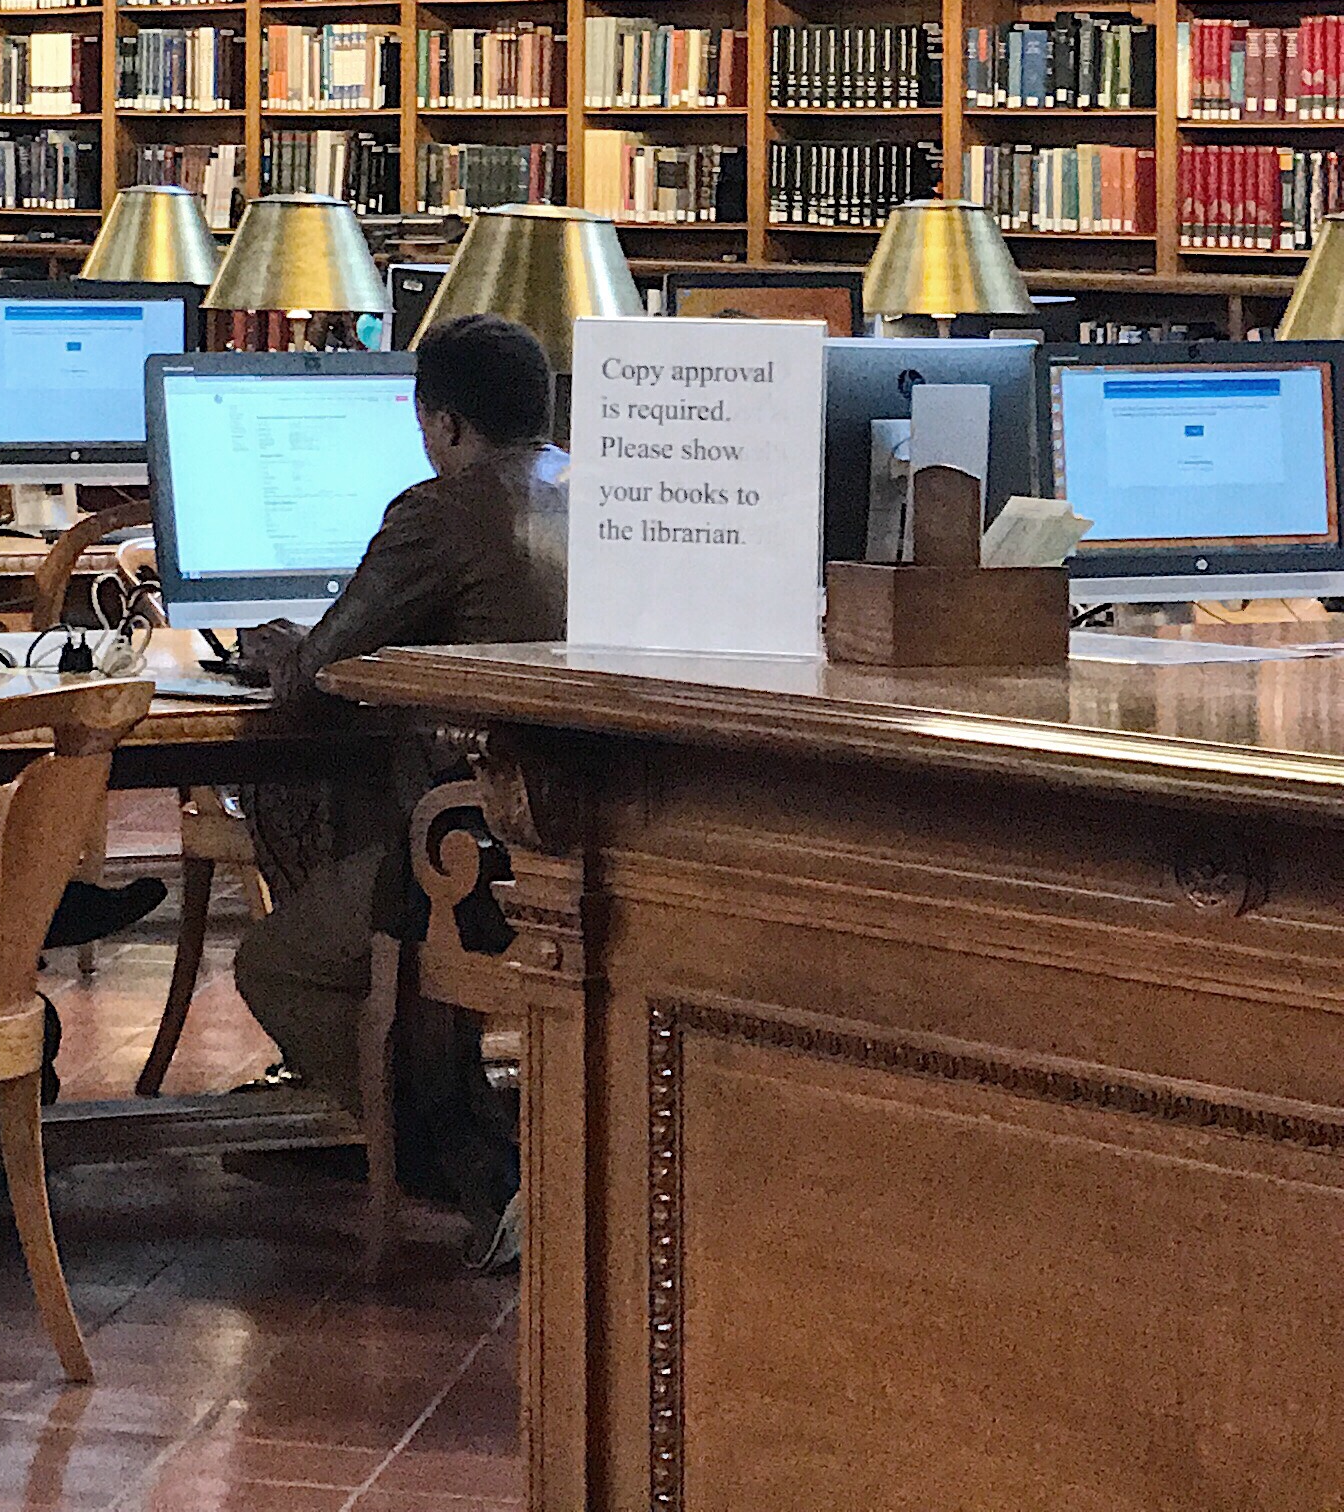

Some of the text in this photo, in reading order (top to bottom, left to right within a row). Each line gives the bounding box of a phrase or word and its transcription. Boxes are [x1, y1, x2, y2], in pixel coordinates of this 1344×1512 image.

[601, 357, 774, 388] Copy approval
[600, 396, 732, 426] is required.
[600, 436, 744, 461] Please show
[599, 481, 760, 507] your books to
[599, 519, 747, 545] the librarian.
